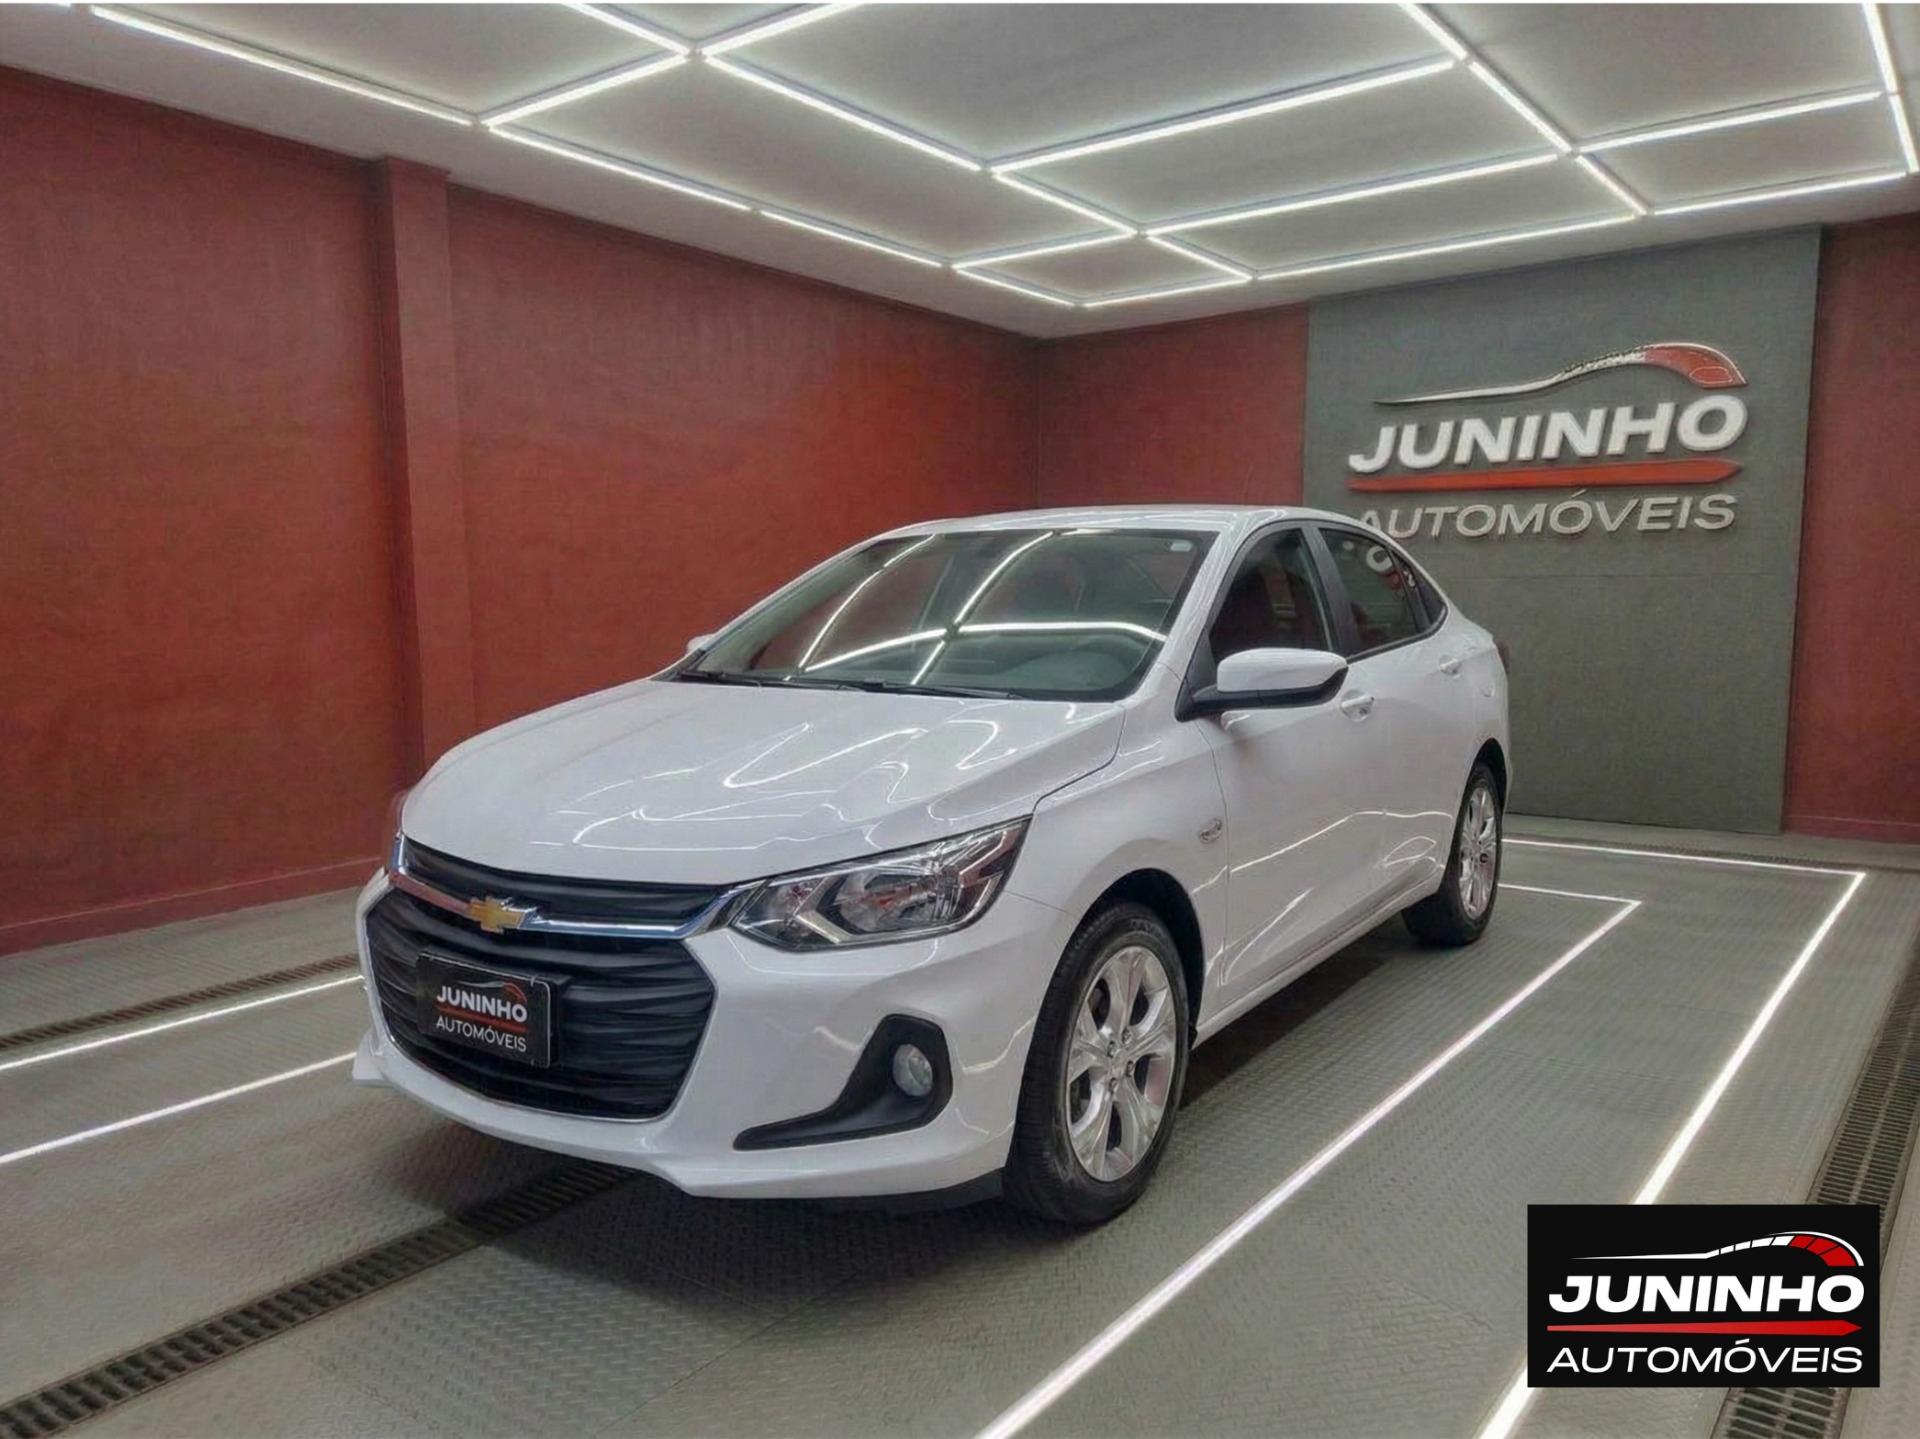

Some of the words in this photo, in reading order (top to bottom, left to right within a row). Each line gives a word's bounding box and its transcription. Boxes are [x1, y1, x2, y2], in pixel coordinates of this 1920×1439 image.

[1348, 395, 1748, 472] JUNINHO
[1361, 489, 1737, 538] AUTOMÓVEIS
[437, 985, 528, 1022] JUNINHO
[436, 1016, 527, 1052] AUTOMÓVEIS
